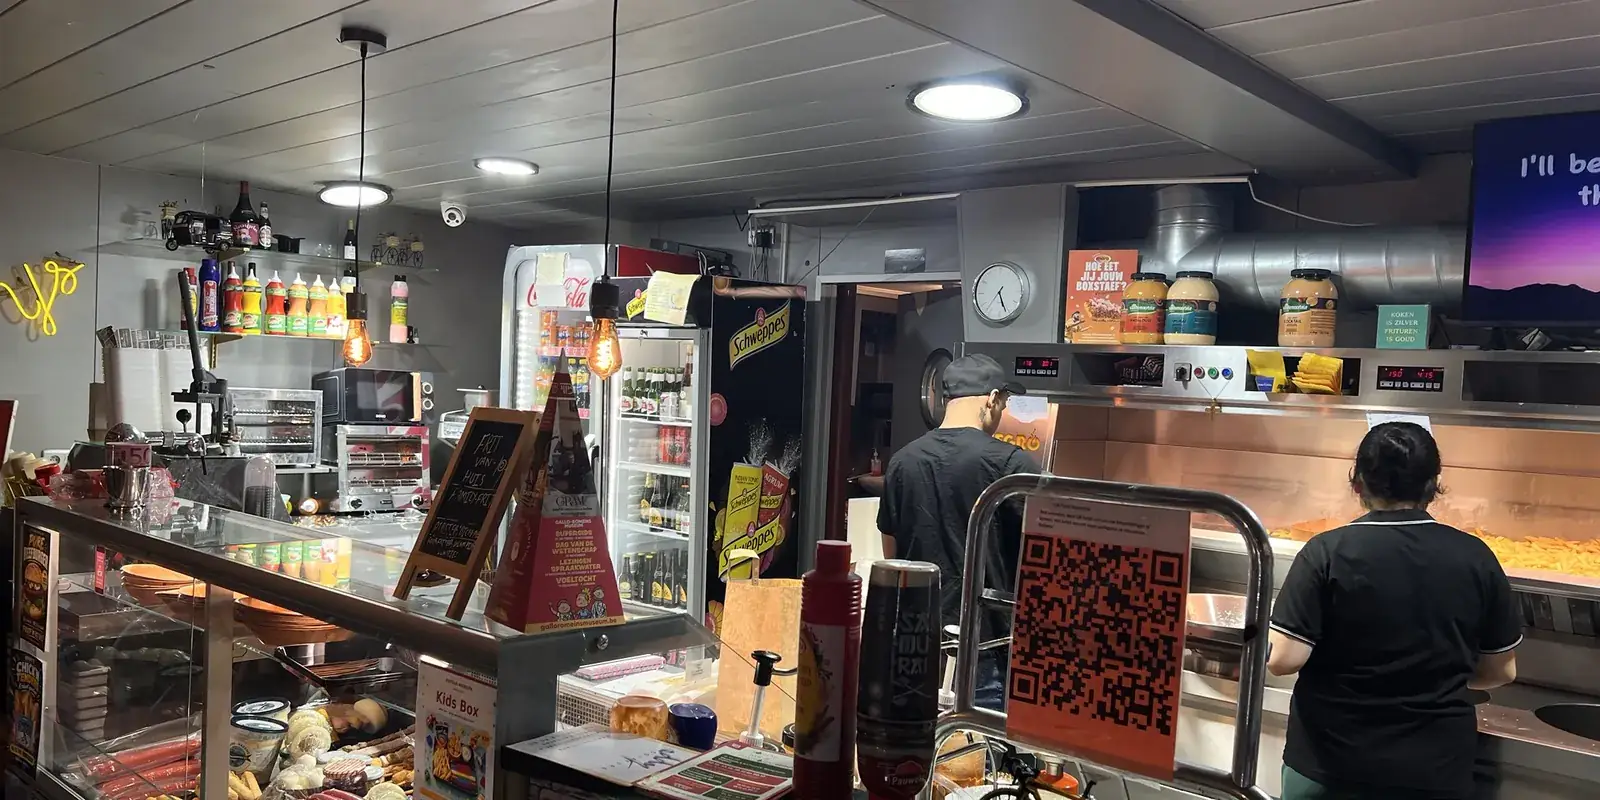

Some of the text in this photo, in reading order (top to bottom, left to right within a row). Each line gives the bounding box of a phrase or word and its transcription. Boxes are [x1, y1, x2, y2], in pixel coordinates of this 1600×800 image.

[1521, 153, 1600, 178] I'll be
[1085, 261, 1119, 271] HOE EET
[1080, 271, 1123, 281] JIJ JOUW
[734, 313, 786, 357] Schweppes
[473, 433, 503, 455] FRIT
[462, 470, 486, 487] HUIS
[552, 546, 597, 554] WETENSCHAP
[551, 564, 601, 572] SPRAAKWATER
[556, 575, 597, 584] VOELTOCHT
[436, 690, 457, 709] Kids
[460, 699, 479, 717] Box
